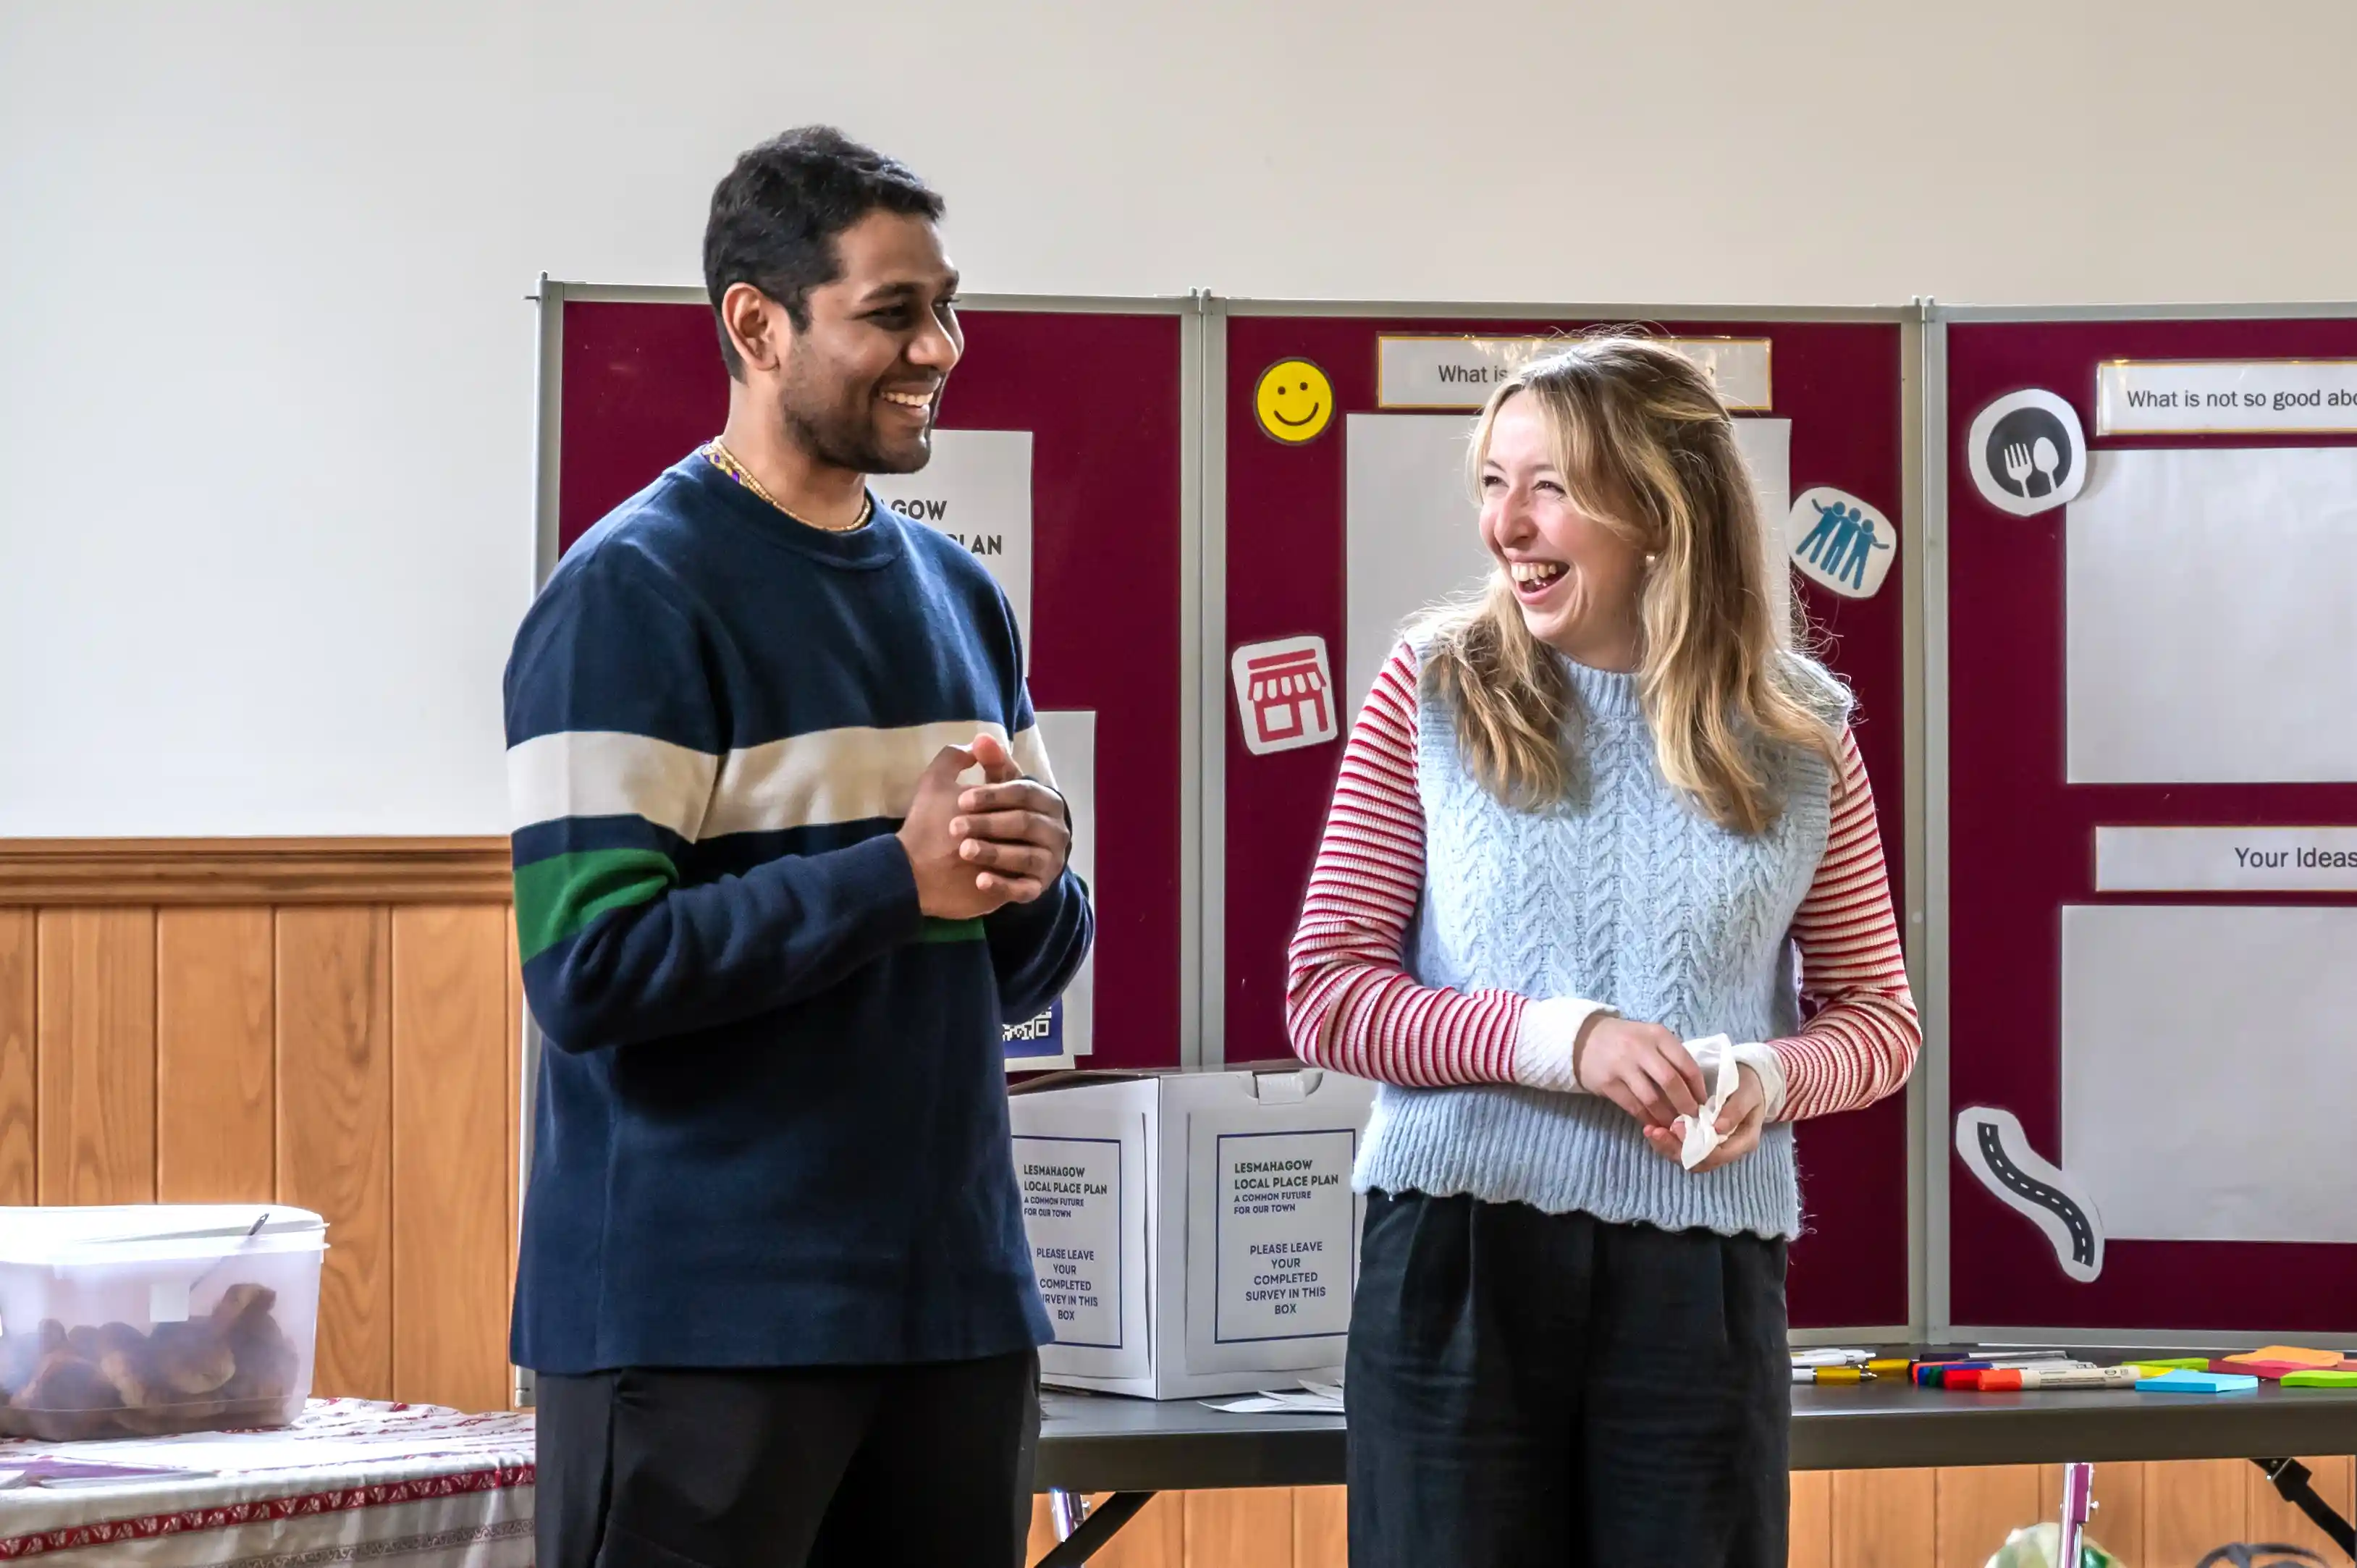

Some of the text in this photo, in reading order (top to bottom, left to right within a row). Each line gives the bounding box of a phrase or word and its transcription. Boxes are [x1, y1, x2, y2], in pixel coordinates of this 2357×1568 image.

[1438, 365, 1488, 383] What
[2128, 390, 2178, 407] What
[2185, 390, 2200, 407] is
[2206, 391, 2238, 407] not
[2244, 393, 2267, 406] so
[2273, 389, 2321, 410] good
[881, 499, 948, 520] GOW
[2235, 847, 2357, 867] Your Ideas
[1024, 1164, 1085, 1178] LESMAHAGOW
[1234, 1160, 1313, 1173] LESMAHAGOW
[1024, 1180, 1107, 1194] LOCAL PLACE PLAN
[1234, 1174, 1338, 1189] LOCAL PLACE PLAN
[1030, 1196, 1058, 1205] COMMON
[1060, 1198, 1084, 1207] FUTURE
[1242, 1192, 1279, 1202] COMMON
[1281, 1191, 1311, 1200] FUTURE
[1024, 1207, 1037, 1216] FOR
[1038, 1208, 1051, 1217] OUR
[1234, 1203, 1296, 1215] FOR OUR TOWN
[1037, 1248, 1094, 1260] PLEASE LEAVE
[1250, 1242, 1323, 1255] PLEASE LEAVE
[1053, 1264, 1076, 1274] YOUR
[1271, 1258, 1301, 1269] YOUR
[1040, 1278, 1092, 1291] COMPLETED
[1254, 1272, 1318, 1285] COMPLETED
[1245, 1286, 1326, 1301] SURVEY IN THIS
[1068, 1297, 1076, 1305] IN
[1079, 1296, 1098, 1307] THIS
[1058, 1310, 1075, 1320] BOX
[1275, 1304, 1296, 1315] BOX
